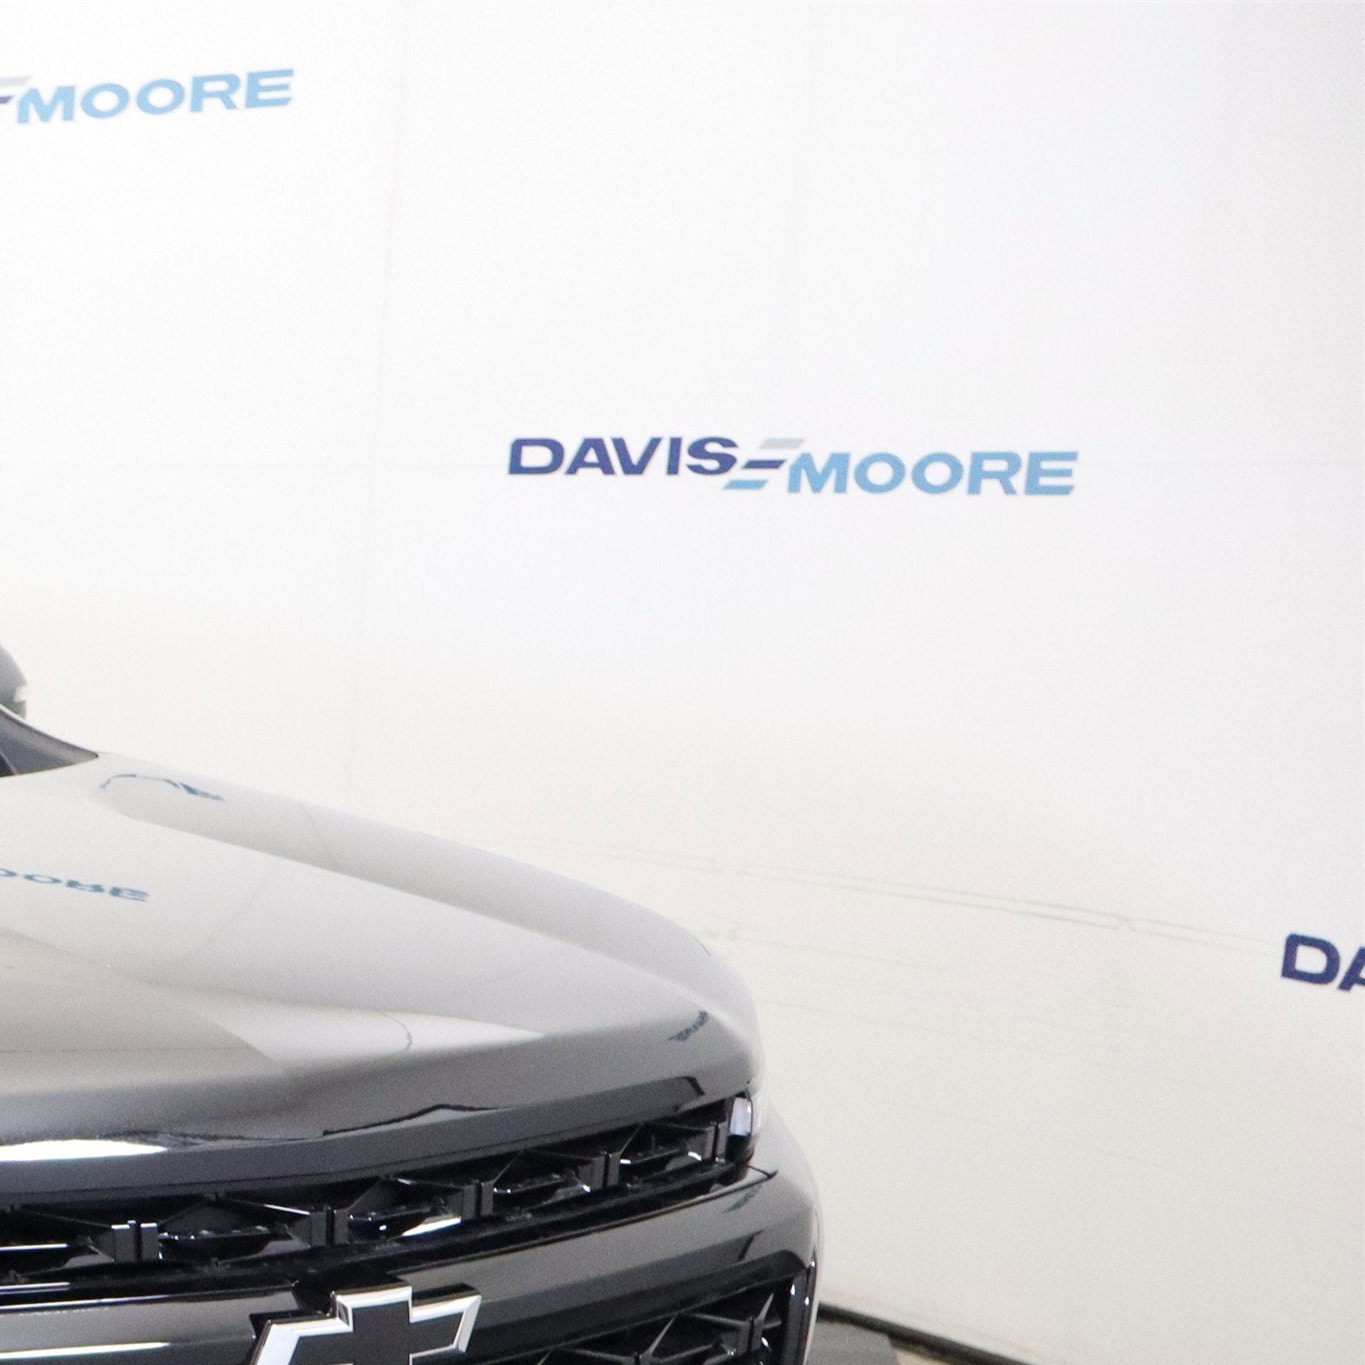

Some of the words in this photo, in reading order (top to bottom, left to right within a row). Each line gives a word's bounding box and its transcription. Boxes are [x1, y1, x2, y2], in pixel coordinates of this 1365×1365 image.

[17, 69, 295, 123] MOORE
[507, 436, 740, 476] DAVIS
[787, 450, 1079, 496] MOORE
